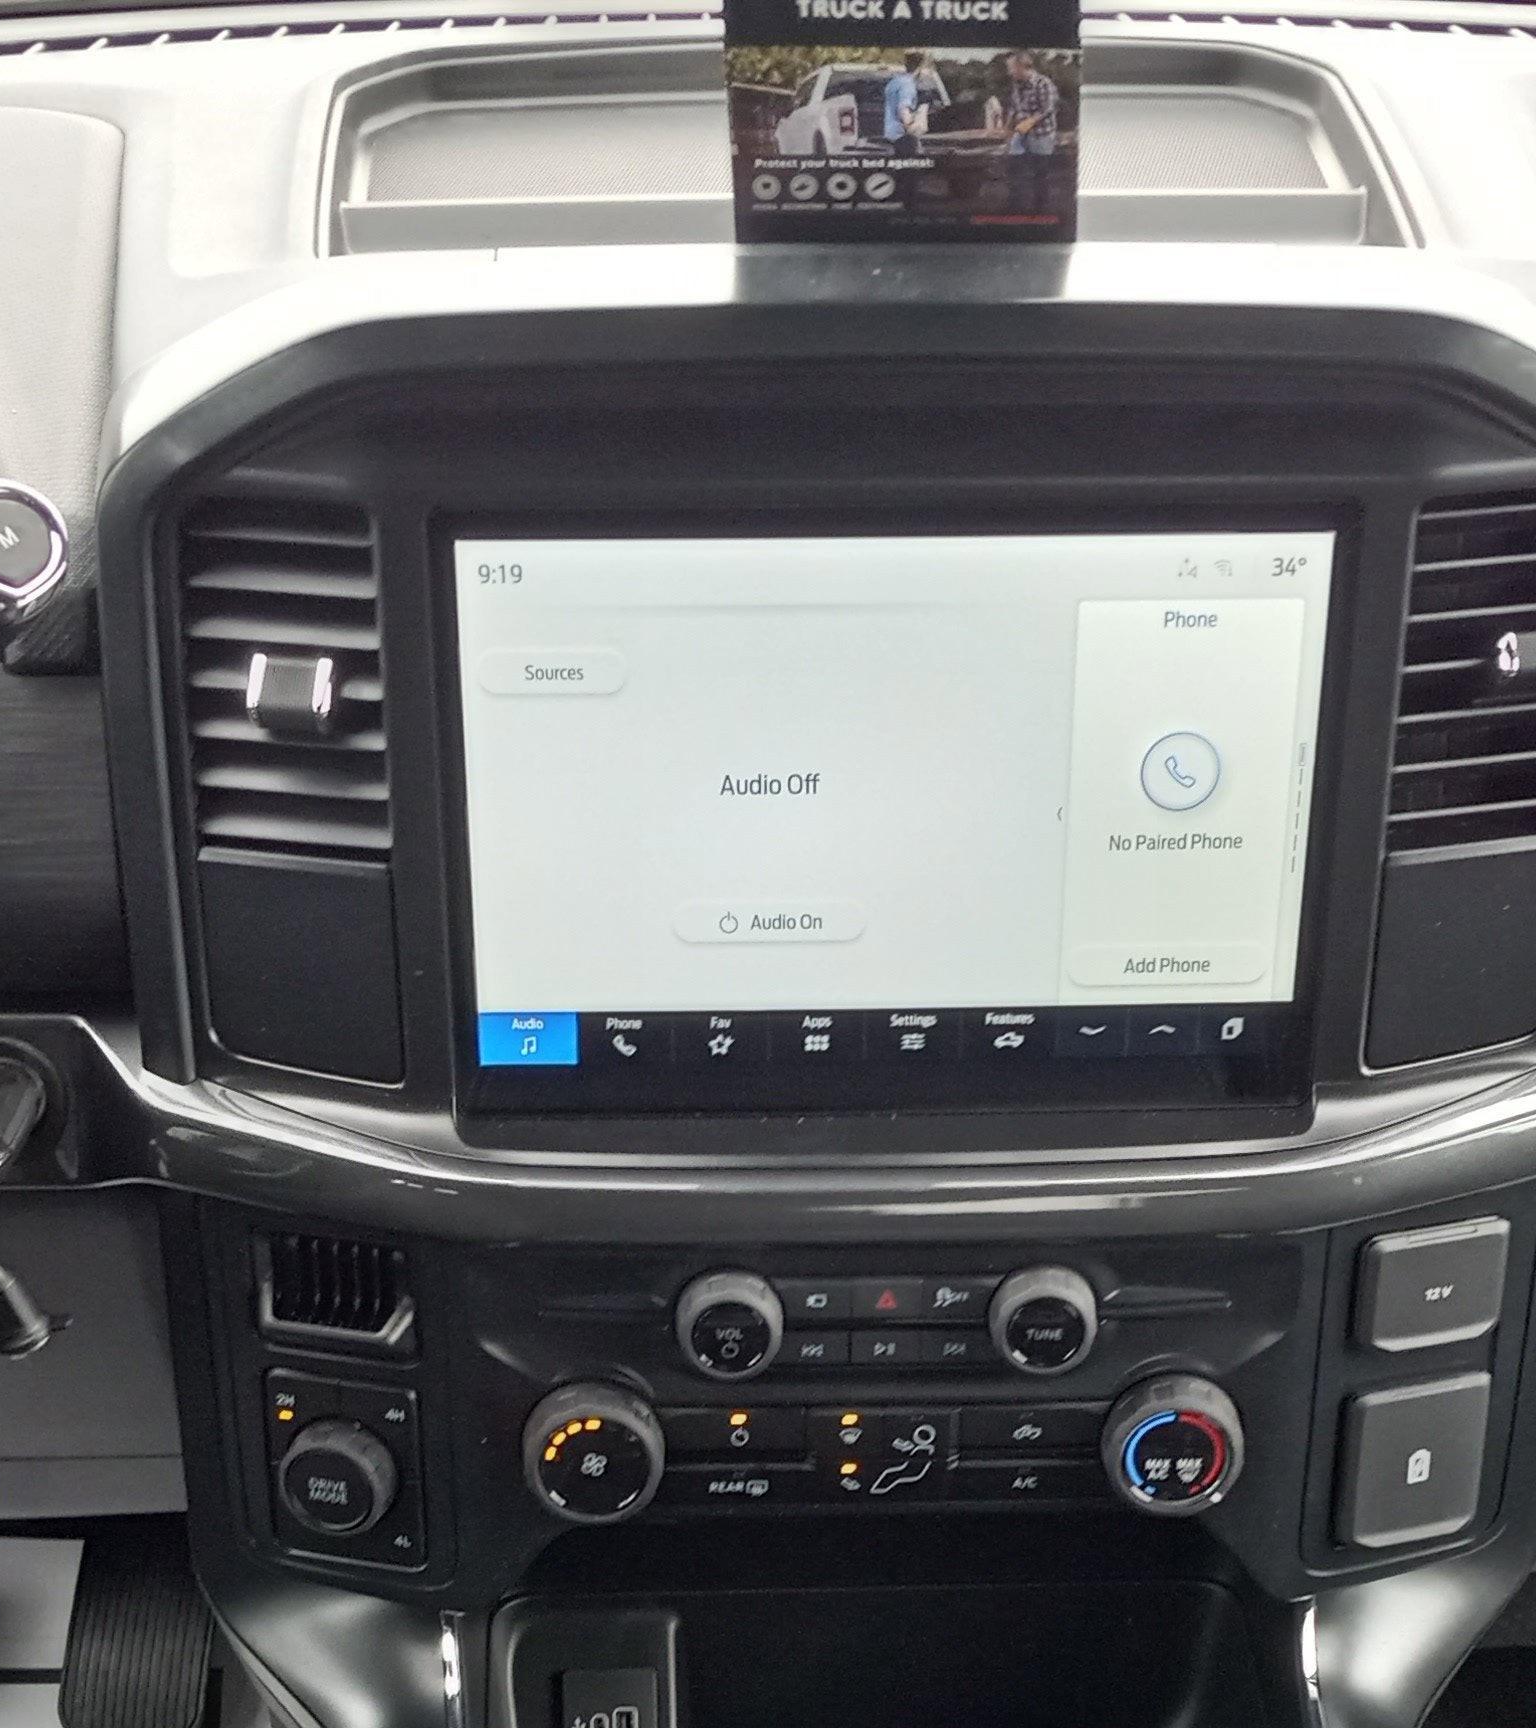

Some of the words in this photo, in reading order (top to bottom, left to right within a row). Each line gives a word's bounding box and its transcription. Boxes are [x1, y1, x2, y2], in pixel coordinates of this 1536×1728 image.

[798, 0, 885, 19] TRUCK
[892, 0, 912, 20] A
[921, 0, 1009, 21] TRUCK
[799, 159, 826, 170] your
[829, 158, 859, 168] truck
[477, 564, 523, 585] 9:19
[1271, 557, 1308, 577] 34°
[1164, 611, 1218, 628] Phone
[524, 664, 584, 682] Sources
[720, 773, 782, 797] Audio
[787, 773, 821, 796] Off
[1108, 835, 1132, 851] No
[1135, 833, 1187, 851] Paired
[1190, 833, 1243, 850] Phone
[750, 913, 797, 931] Audio
[800, 914, 823, 931] On
[1123, 957, 1156, 974] Add
[1160, 957, 1211, 973] Phone
[511, 1017, 544, 1030] Audio
[605, 1017, 643, 1030] Phone
[710, 1017, 732, 1030] Fav
[802, 1014, 833, 1030] Apps
[889, 1012, 938, 1028] Settings
[984, 1012, 1035, 1027] Features
[1424, 1284, 1454, 1301] 12V
[716, 1328, 744, 1340] VOL
[1026, 1328, 1064, 1341] TUNE
[709, 1480, 744, 1494] REAR
[1012, 1477, 1038, 1490] A/C
